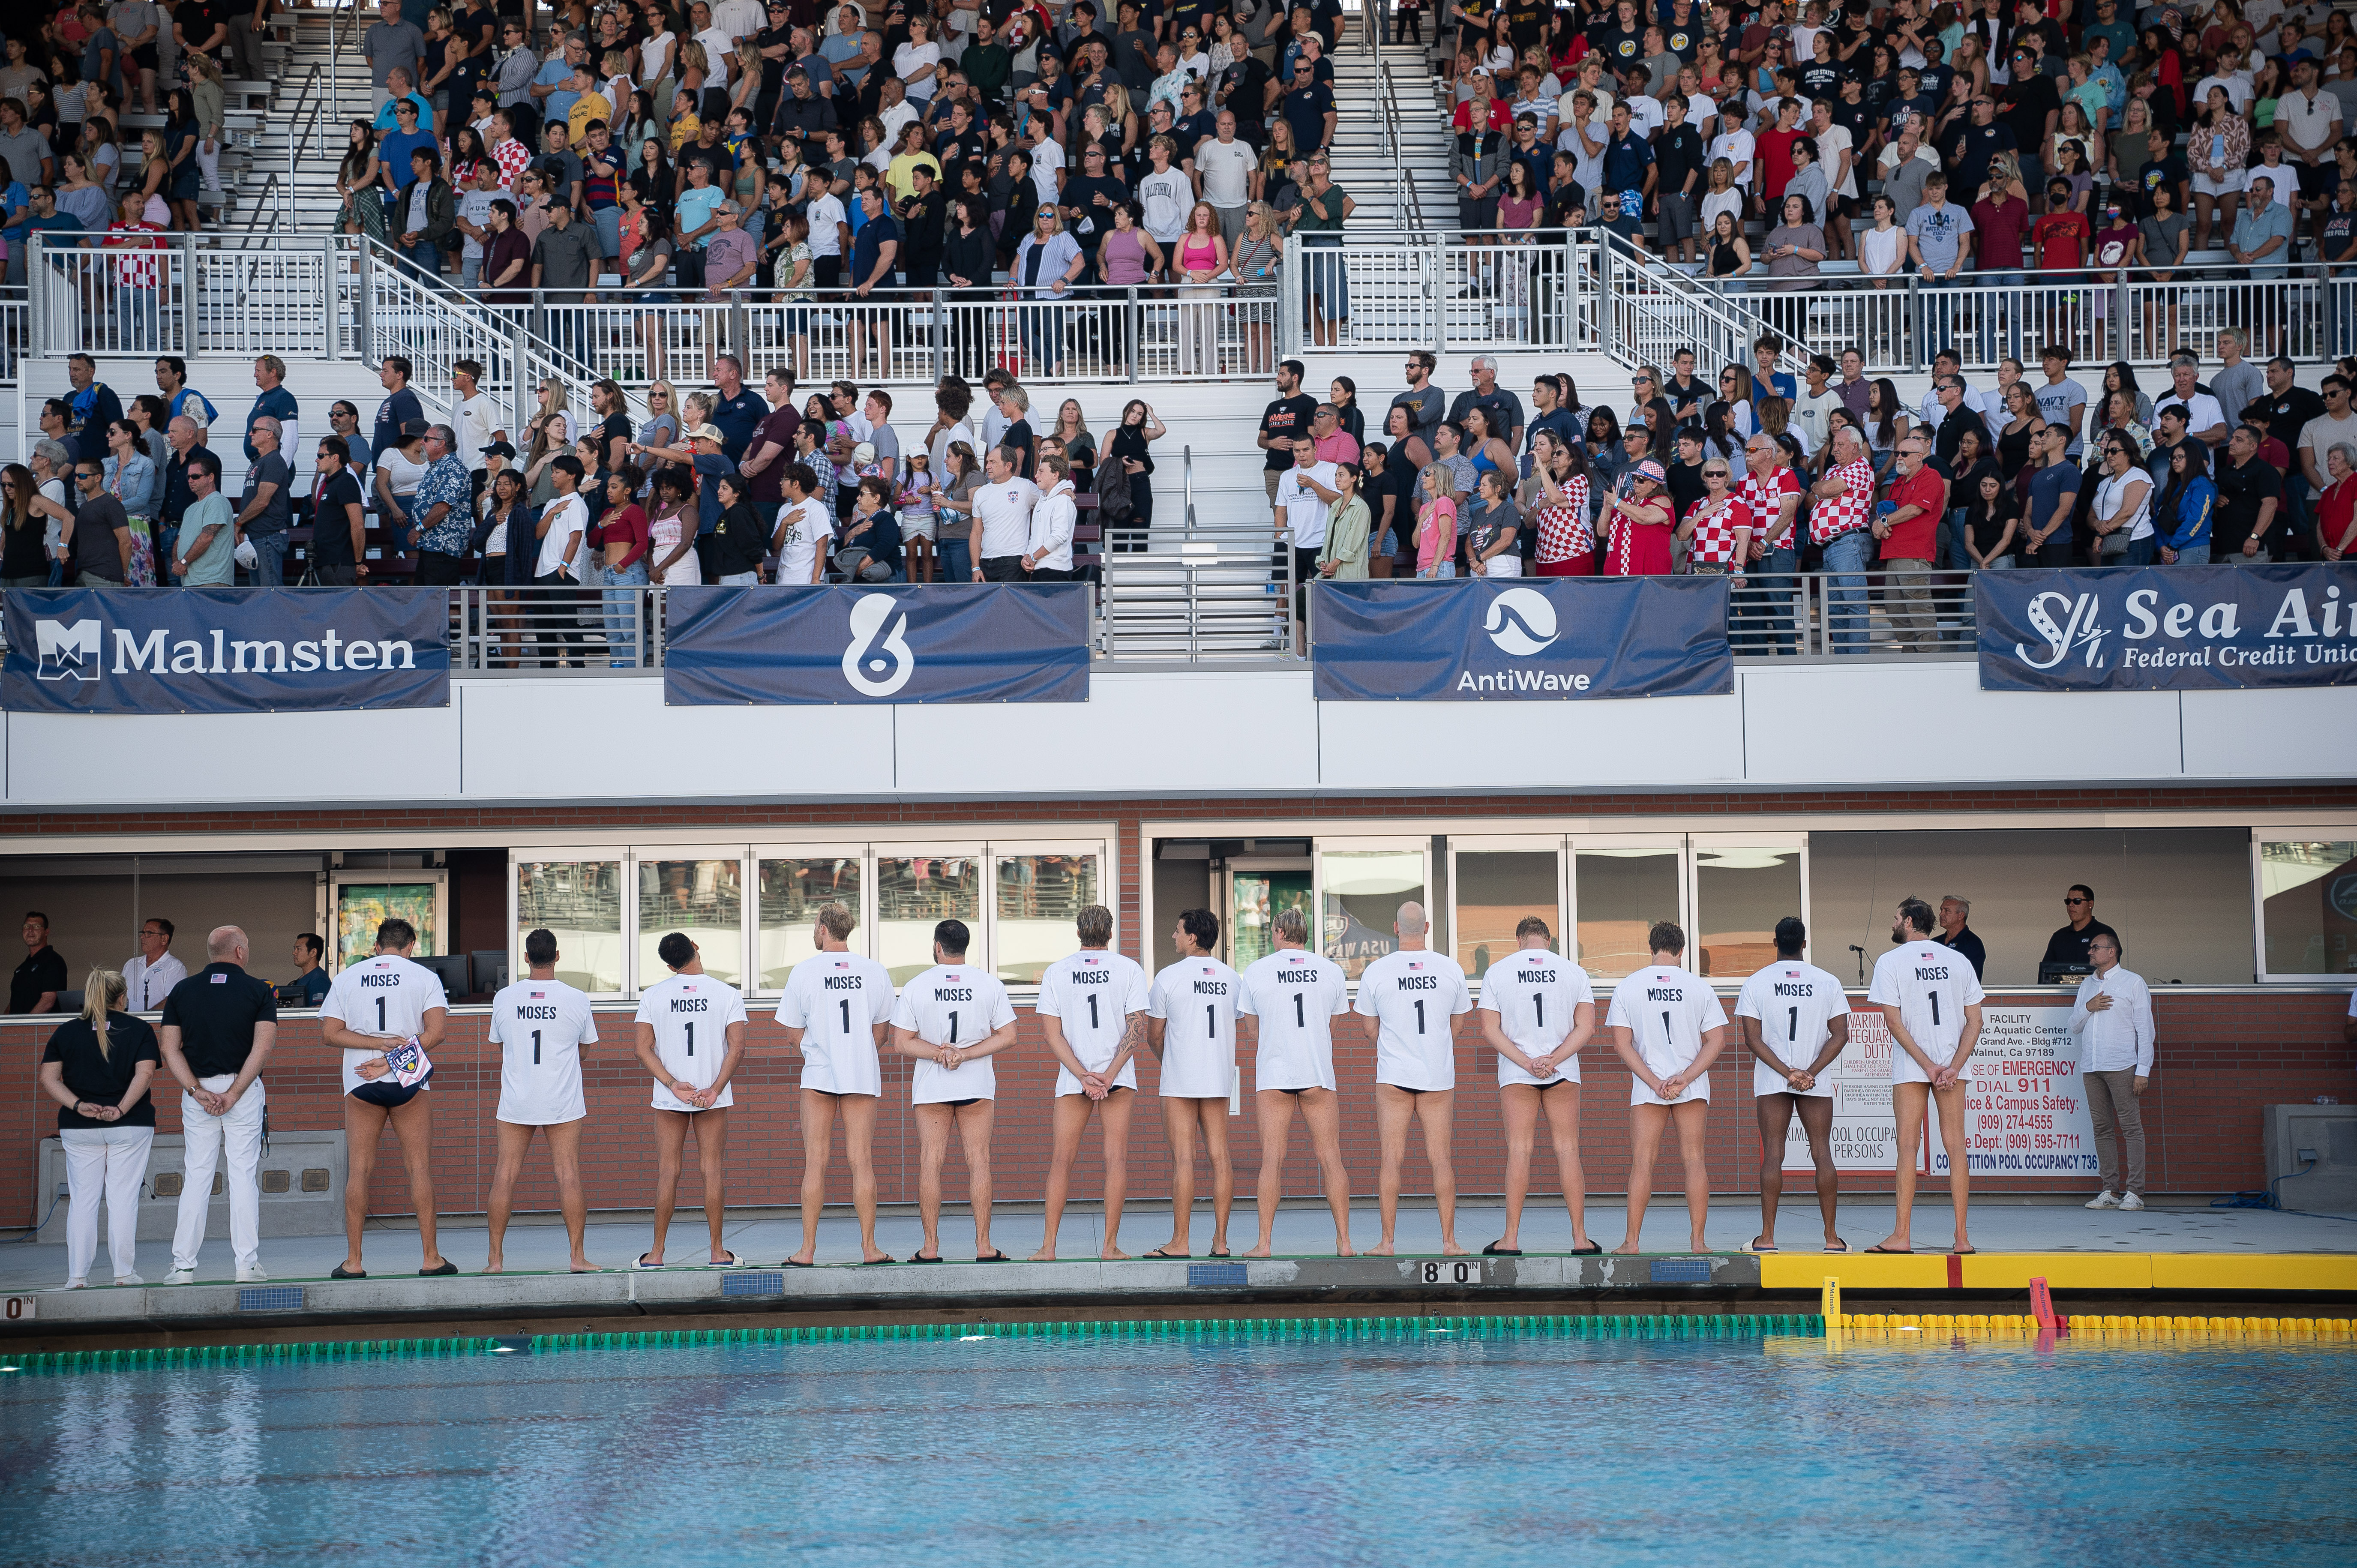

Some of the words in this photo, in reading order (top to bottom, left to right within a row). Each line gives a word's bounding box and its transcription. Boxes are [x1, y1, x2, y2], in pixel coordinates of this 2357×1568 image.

[1928, 215, 1950, 225] UA
[2037, 396, 2066, 407] NAVY
[2123, 590, 2240, 639] Sea
[112, 629, 415, 674] Malmsten
[2123, 647, 2210, 667] Federal
[2219, 645, 2296, 666] Credit
[1457, 669, 1589, 691] AntiWave
[361, 974, 400, 986] MOSES
[825, 976, 862, 989] MOSES
[1073, 971, 1109, 983] MOSES
[1277, 970, 1317, 983] MOSES
[1398, 976, 1436, 990] MOSES
[1518, 970, 1556, 983] MOSES
[935, 989, 972, 1001] MOSES
[1194, 981, 1226, 995] MOSES
[1647, 988, 1682, 1001] MOSES
[1775, 983, 1812, 996] MOSES
[517, 1006, 556, 1019] MOSES
[671, 998, 708, 1012] MOSES
[1088, 994, 1098, 1028] 1
[1294, 993, 1304, 1028] 1
[1533, 993, 1542, 1027] 1
[1928, 991, 1940, 1025] 1
[376, 997, 385, 1031] 1
[840, 999, 849, 1033] 1
[1207, 1004, 1214, 1038] 1
[1414, 1000, 1424, 1034] 1
[1847, 1014, 1886, 1028] WARNIN
[1990, 1015, 2031, 1023] FACILITY
[949, 1011, 957, 1043] 1
[1662, 1011, 1672, 1044] 1
[1789, 1007, 1797, 1041] 1
[1994, 1026, 2031, 1035] Aquatic
[685, 1022, 693, 1056] 1
[2032, 1037, 2050, 1047] Bldg
[532, 1030, 540, 1064] 1
[1865, 1044, 1892, 1058] DUTY
[1970, 1049, 2006, 1057] Walnut,
[396, 1049, 415, 1065] USA
[1988, 1064, 1999, 1075] OF
[2003, 1061, 2075, 1076] EMERGENCY
[1977, 1081, 2013, 1092] DIAL
[2018, 1078, 2050, 1092] 911
[1985, 1095, 1993, 1110] &
[1996, 1095, 2039, 1113] Campus
[2042, 1095, 2079, 1114] Safety:
[1978, 1115, 2003, 1133] (909)
[2006, 1115, 2053, 1129] 274-4555
[1832, 1127, 1853, 1141] OOL
[1975, 1134, 2002, 1152] Dept:
[2006, 1133, 2031, 1152] (909)
[2035, 1133, 2080, 1148] 595-7711
[1835, 1144, 1883, 1158] PERSONS
[1999, 1154, 2022, 1169] POOL
[2025, 1154, 2078, 1169] OCCUPANCY
[2082, 1154, 2098, 1169] 736
[2039, 1291, 2049, 1319] Malmsten
